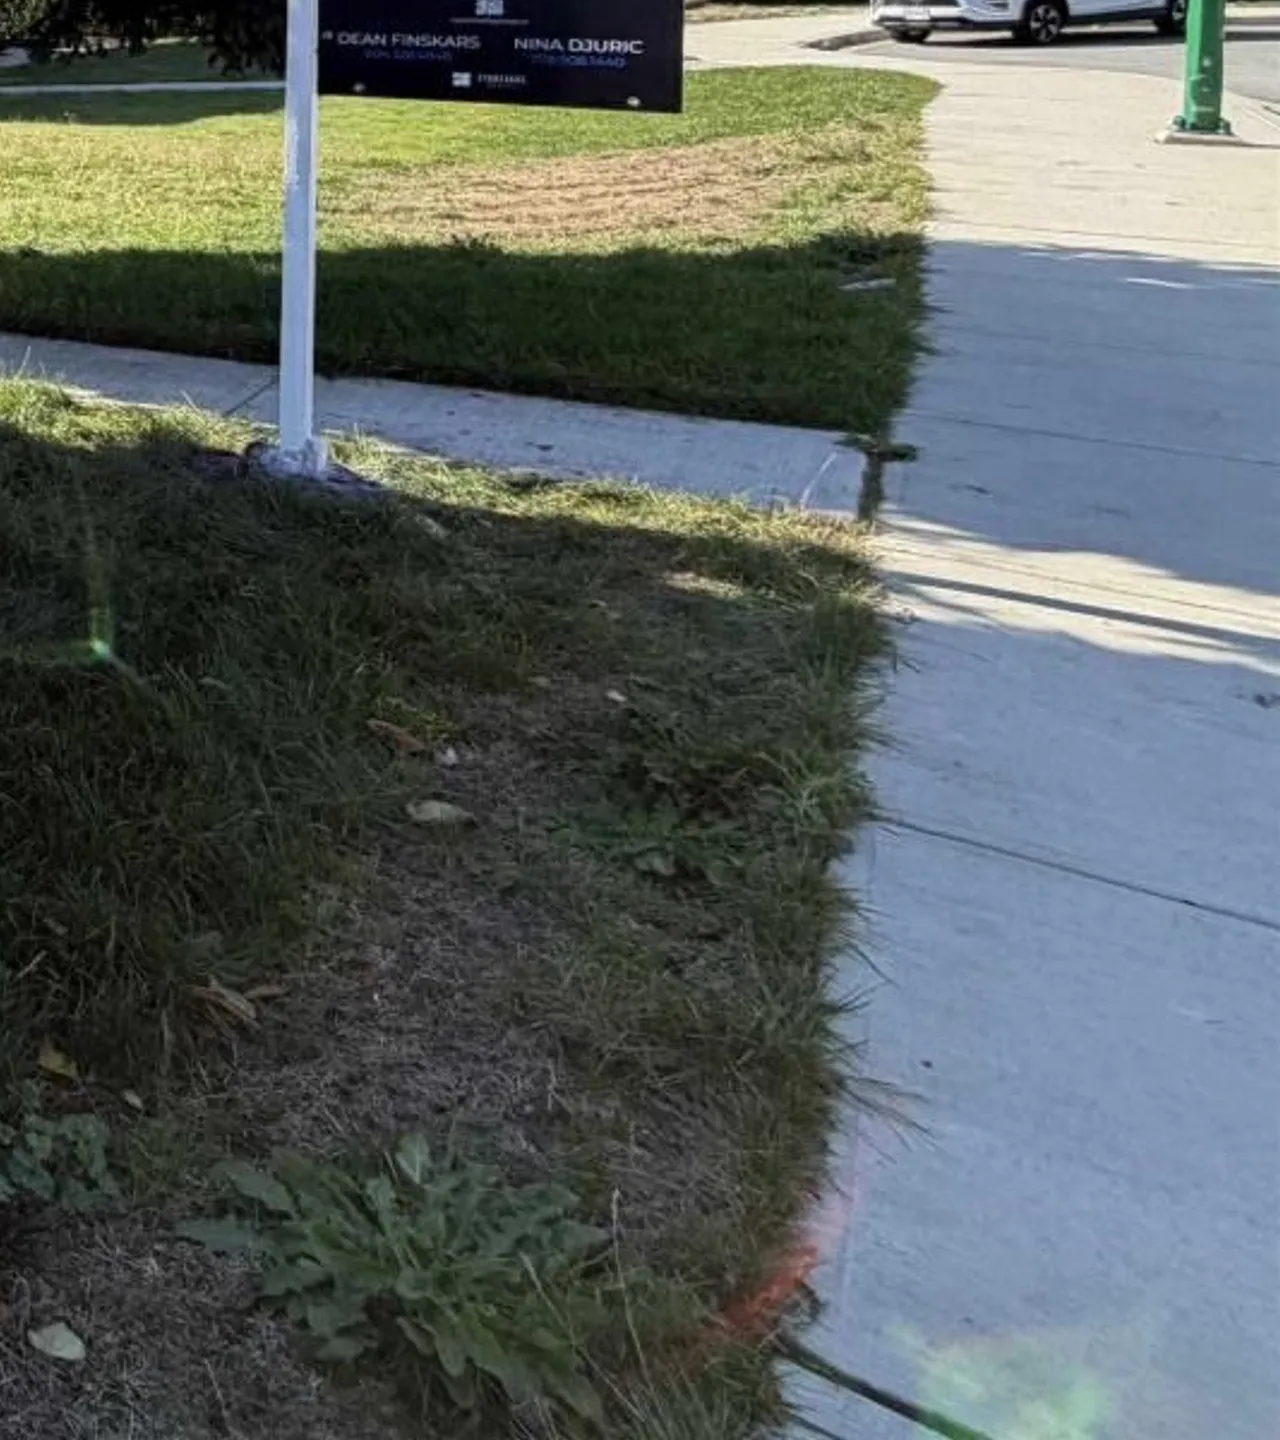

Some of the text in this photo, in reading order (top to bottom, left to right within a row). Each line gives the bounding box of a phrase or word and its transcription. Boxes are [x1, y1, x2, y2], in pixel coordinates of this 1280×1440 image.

[337, 31, 482, 50] DEAN FINSKARS
[514, 38, 644, 55] NINA DJURIC
